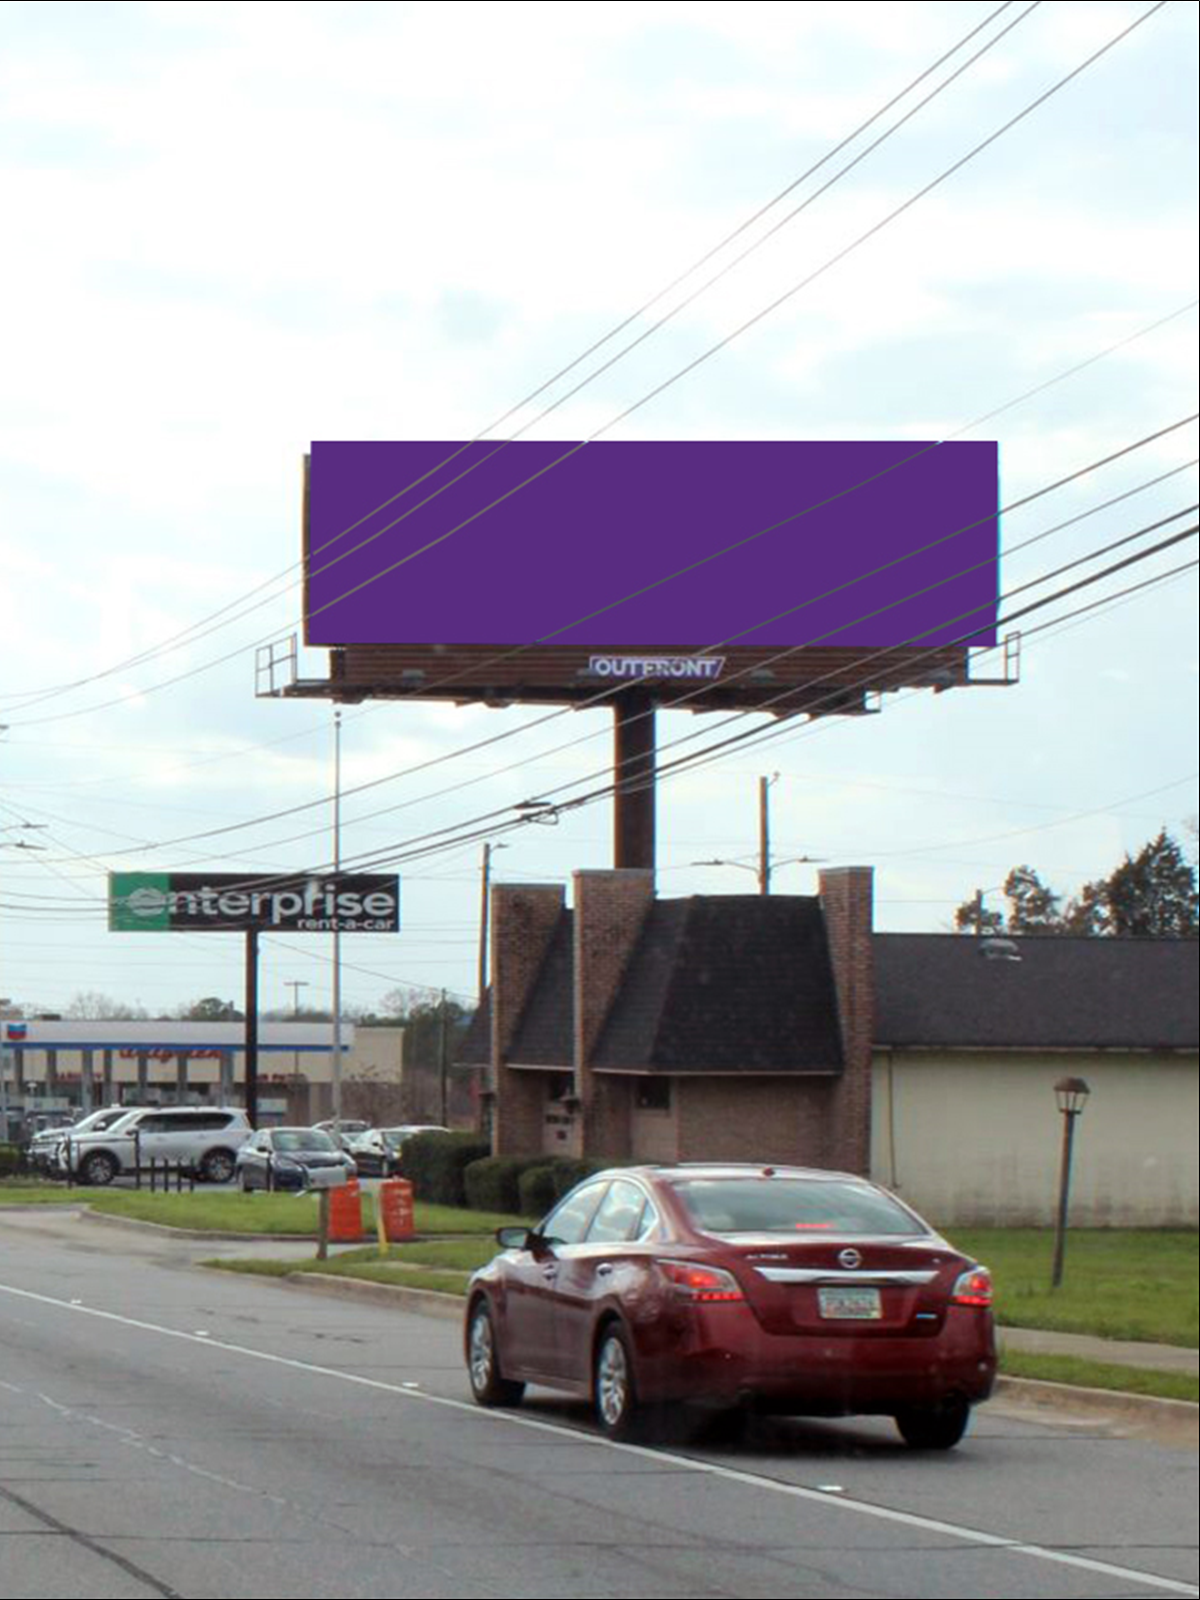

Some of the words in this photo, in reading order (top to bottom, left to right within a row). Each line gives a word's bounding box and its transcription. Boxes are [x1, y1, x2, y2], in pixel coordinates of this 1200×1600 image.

[595, 658, 717, 677] OUTFRONT
[127, 883, 396, 925] enterprise
[297, 917, 394, 931] rent-a-car
